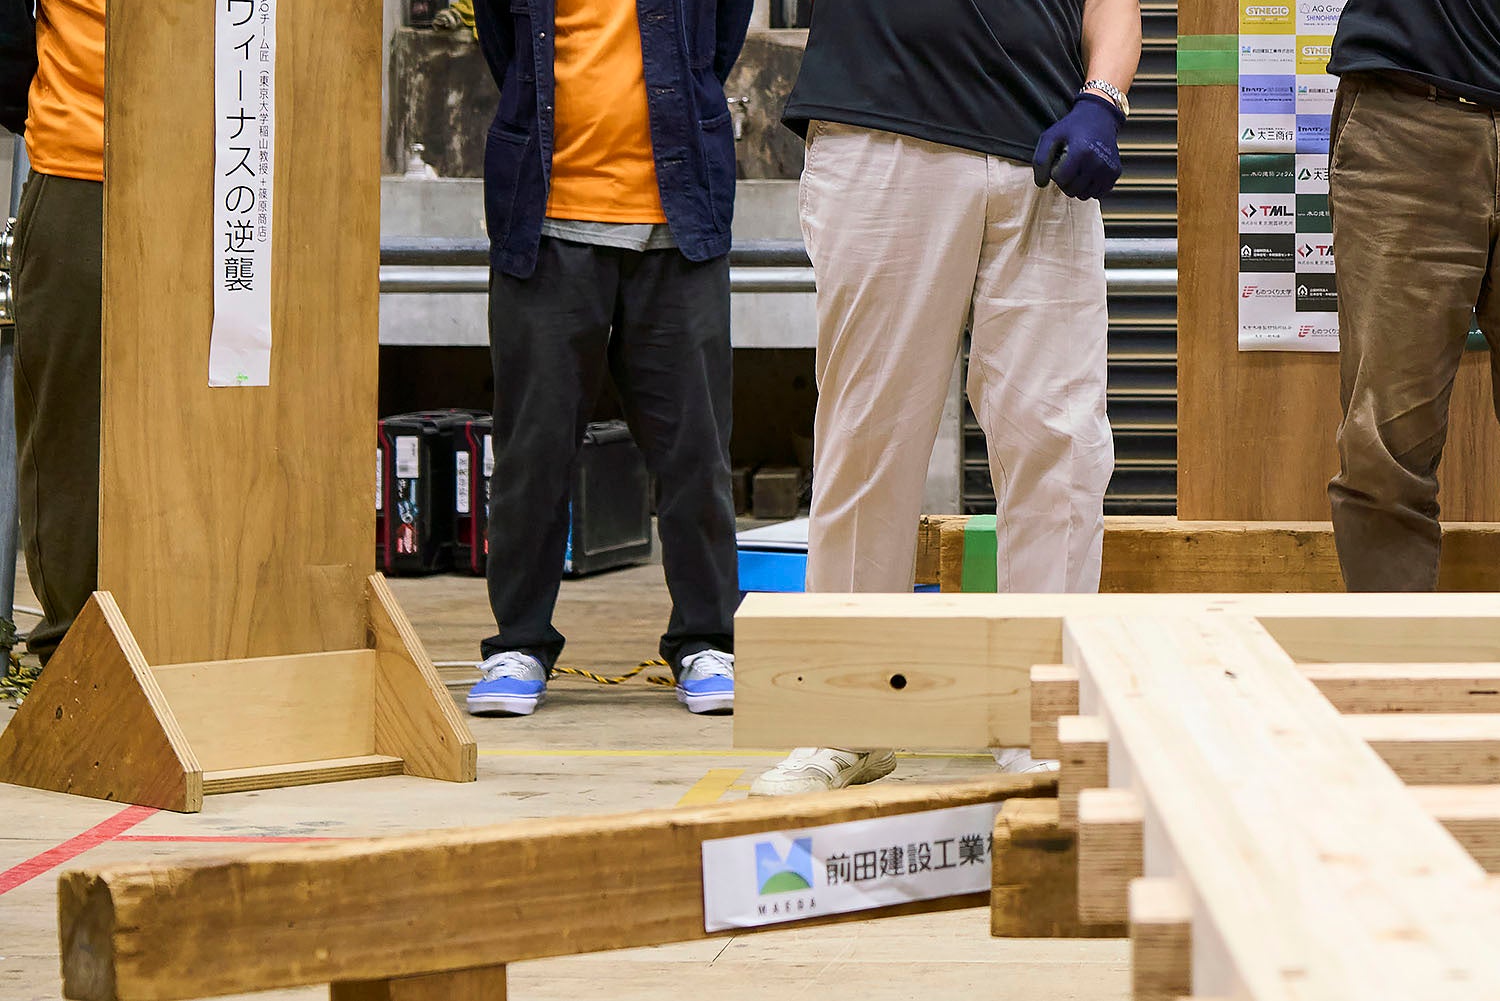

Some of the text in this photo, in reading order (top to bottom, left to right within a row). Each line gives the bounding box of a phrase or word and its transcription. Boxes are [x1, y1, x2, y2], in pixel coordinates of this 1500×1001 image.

[1257, 130, 1293, 140] 大三商行
[1259, 205, 1293, 216] TML
[825, 832, 993, 887] 前田建設工業
[758, 896, 818, 917] MAEDA
